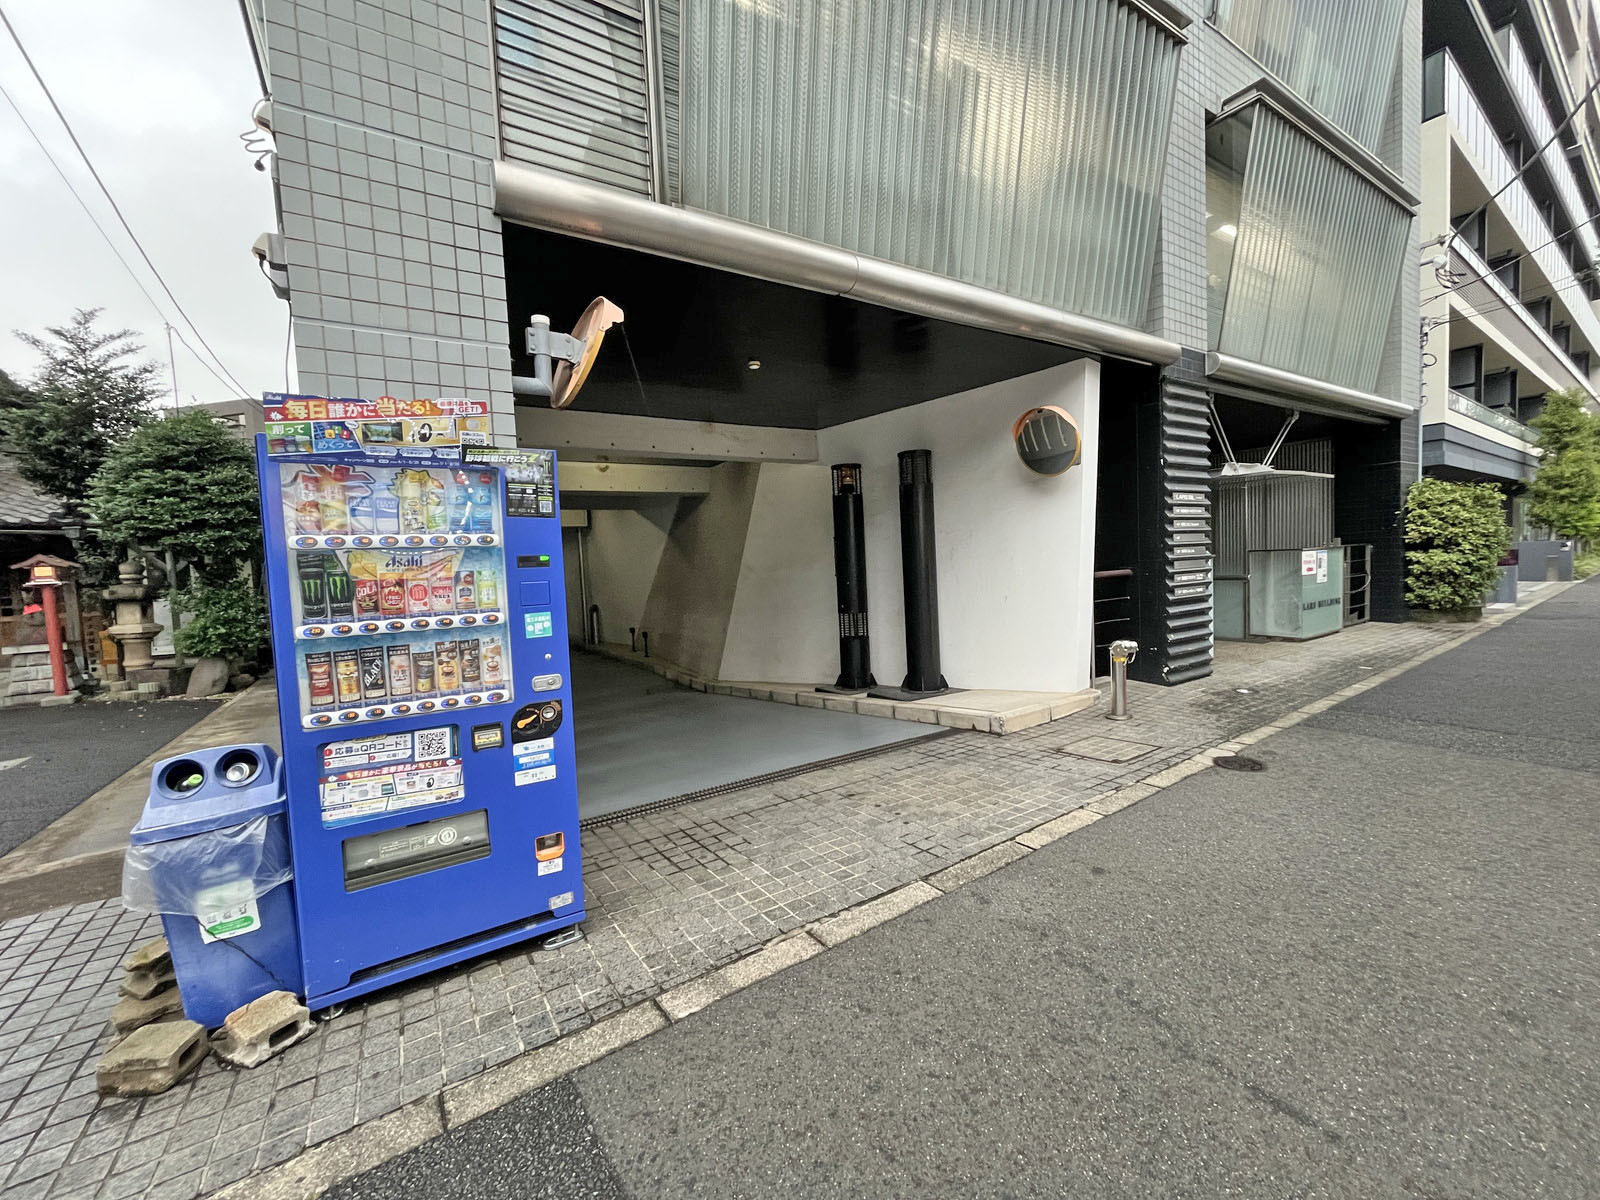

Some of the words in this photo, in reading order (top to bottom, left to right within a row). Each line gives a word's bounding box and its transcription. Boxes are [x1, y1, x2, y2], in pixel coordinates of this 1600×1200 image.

[317, 440, 354, 449] めくって
[385, 554, 424, 568] Asahi
[356, 582, 377, 598] COLA
[363, 658, 384, 687] BLACK
